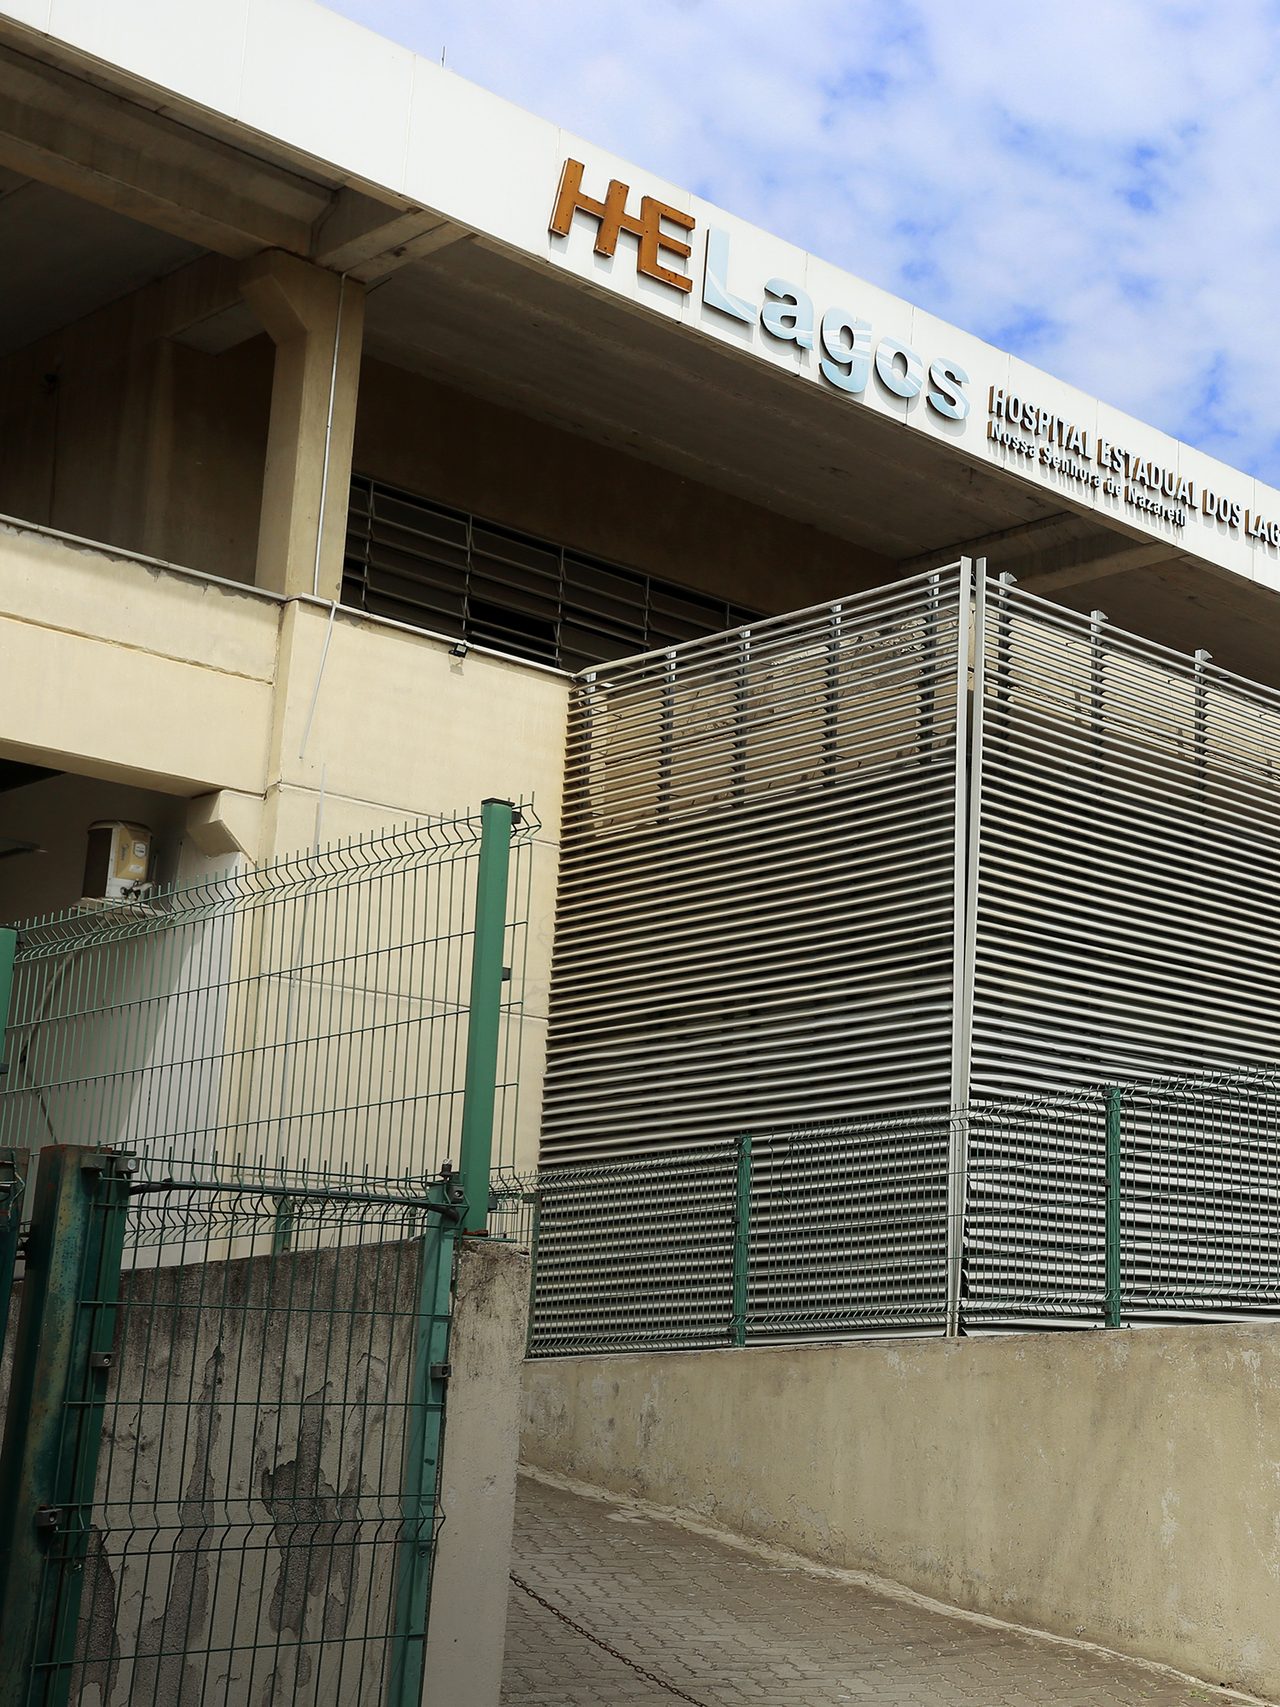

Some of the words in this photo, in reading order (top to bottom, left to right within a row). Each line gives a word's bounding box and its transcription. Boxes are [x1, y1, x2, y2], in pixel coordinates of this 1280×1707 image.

[987, 420, 1036, 458] Nossa
[1039, 444, 1102, 488] Senhora
[1103, 475, 1122, 497] de
[1124, 484, 1188, 527] Nazareth
[988, 385, 1092, 460] HOSPITAL
[1097, 437, 1199, 509] ESTADUAL
[1202, 488, 1242, 528] DOS
